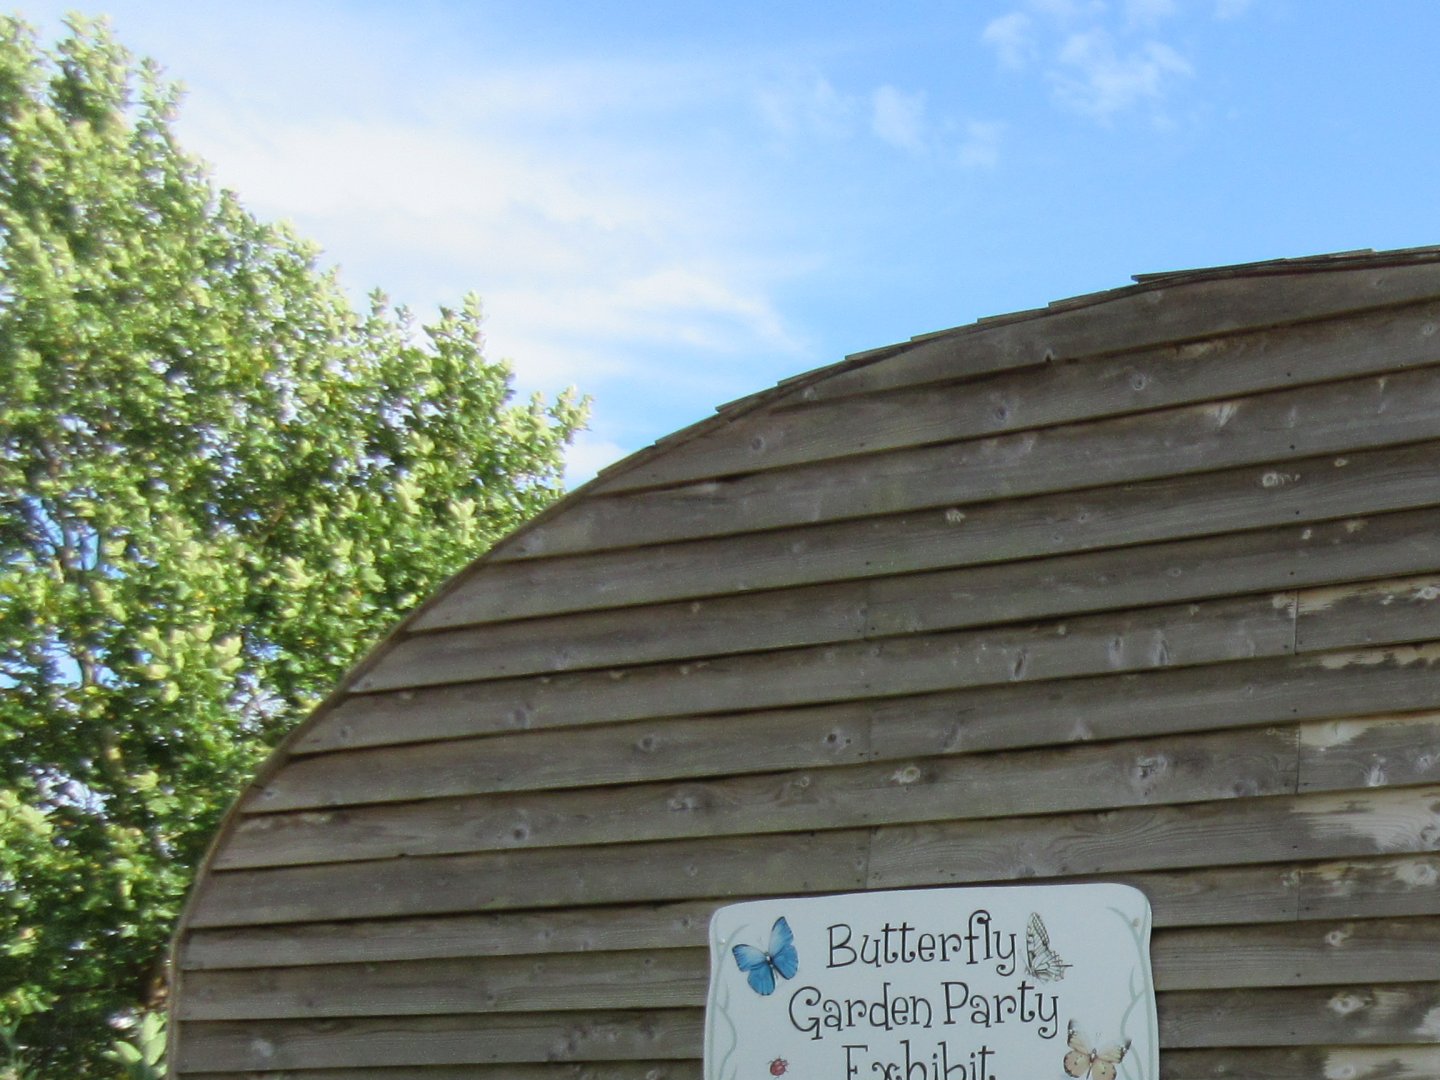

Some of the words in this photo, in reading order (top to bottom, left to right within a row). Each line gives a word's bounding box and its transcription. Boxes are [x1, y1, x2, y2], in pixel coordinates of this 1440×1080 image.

[826, 909, 1017, 976] Butterfly
[788, 983, 933, 1040] Garden
[941, 980, 1059, 1039] Party
